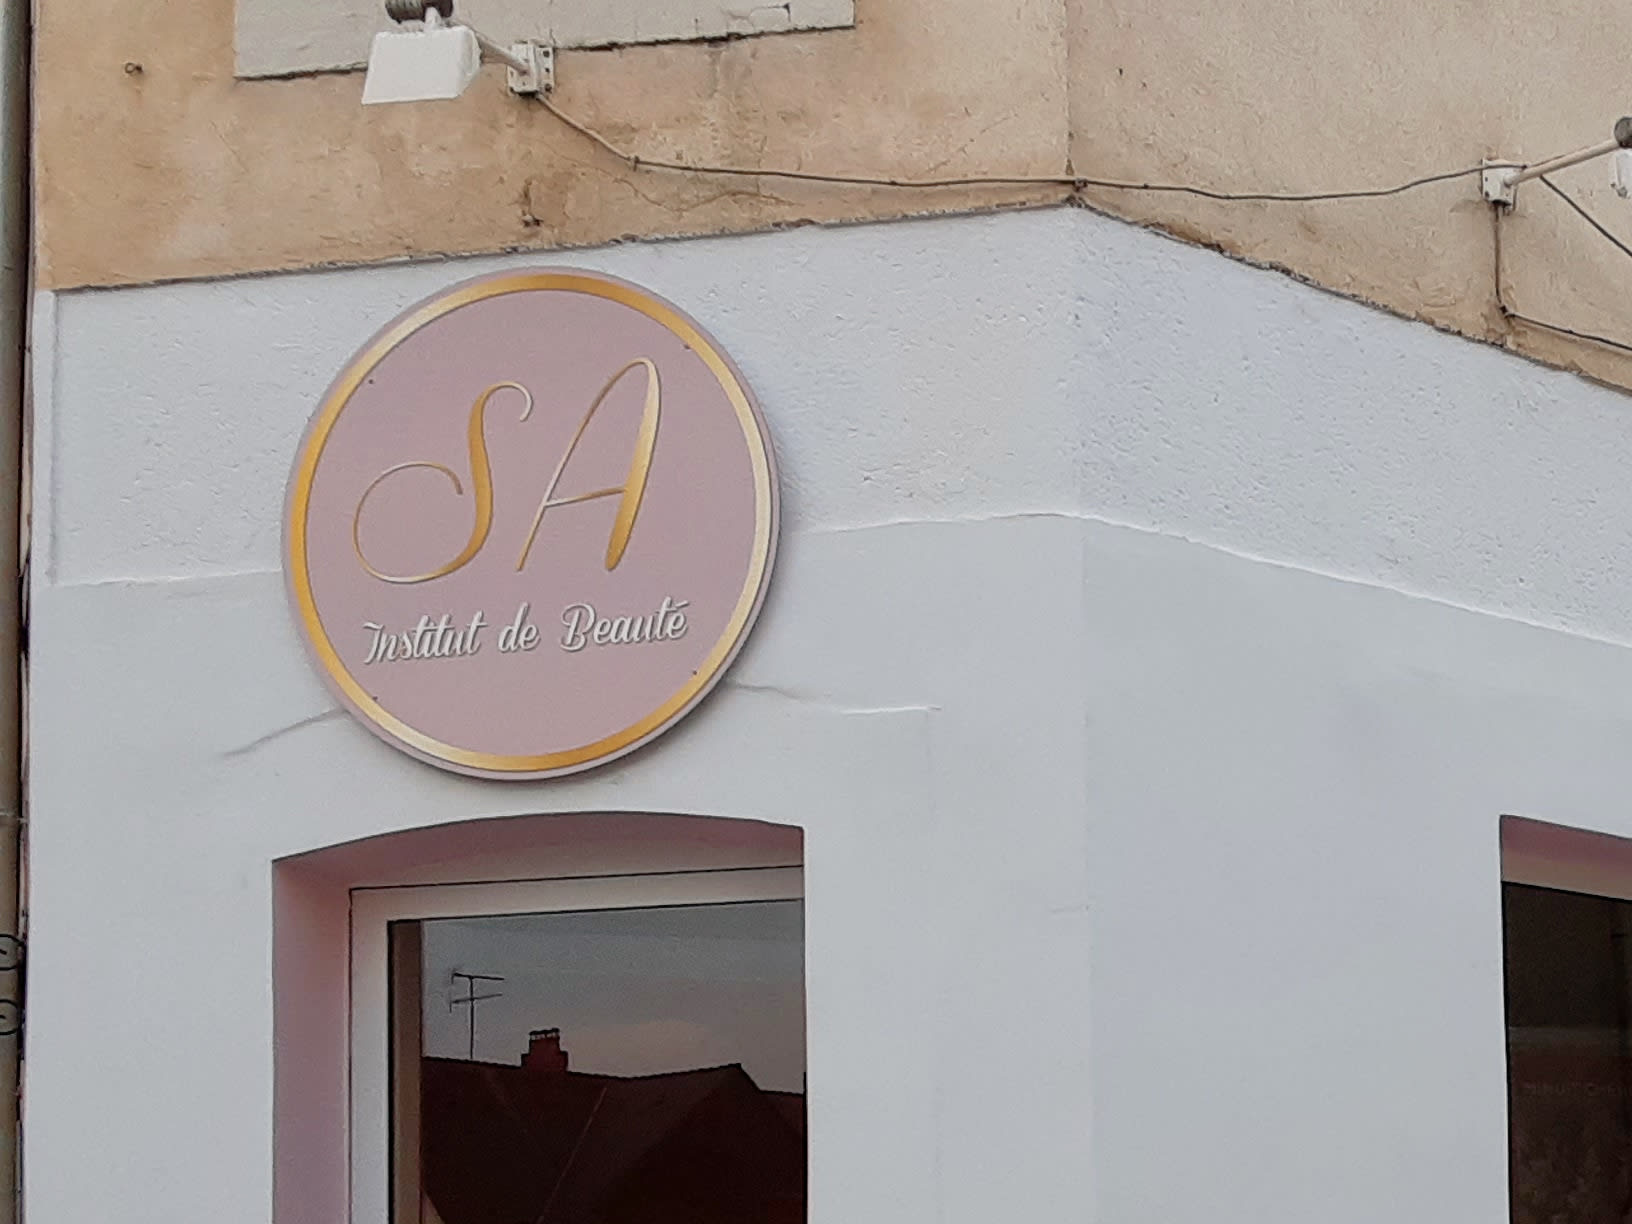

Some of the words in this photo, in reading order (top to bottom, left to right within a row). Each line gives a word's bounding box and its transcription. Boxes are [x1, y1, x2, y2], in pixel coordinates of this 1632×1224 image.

[353, 357, 662, 585] SA
[363, 610, 488, 665] Institut
[498, 602, 540, 653] de
[558, 595, 690, 652] Beauté
